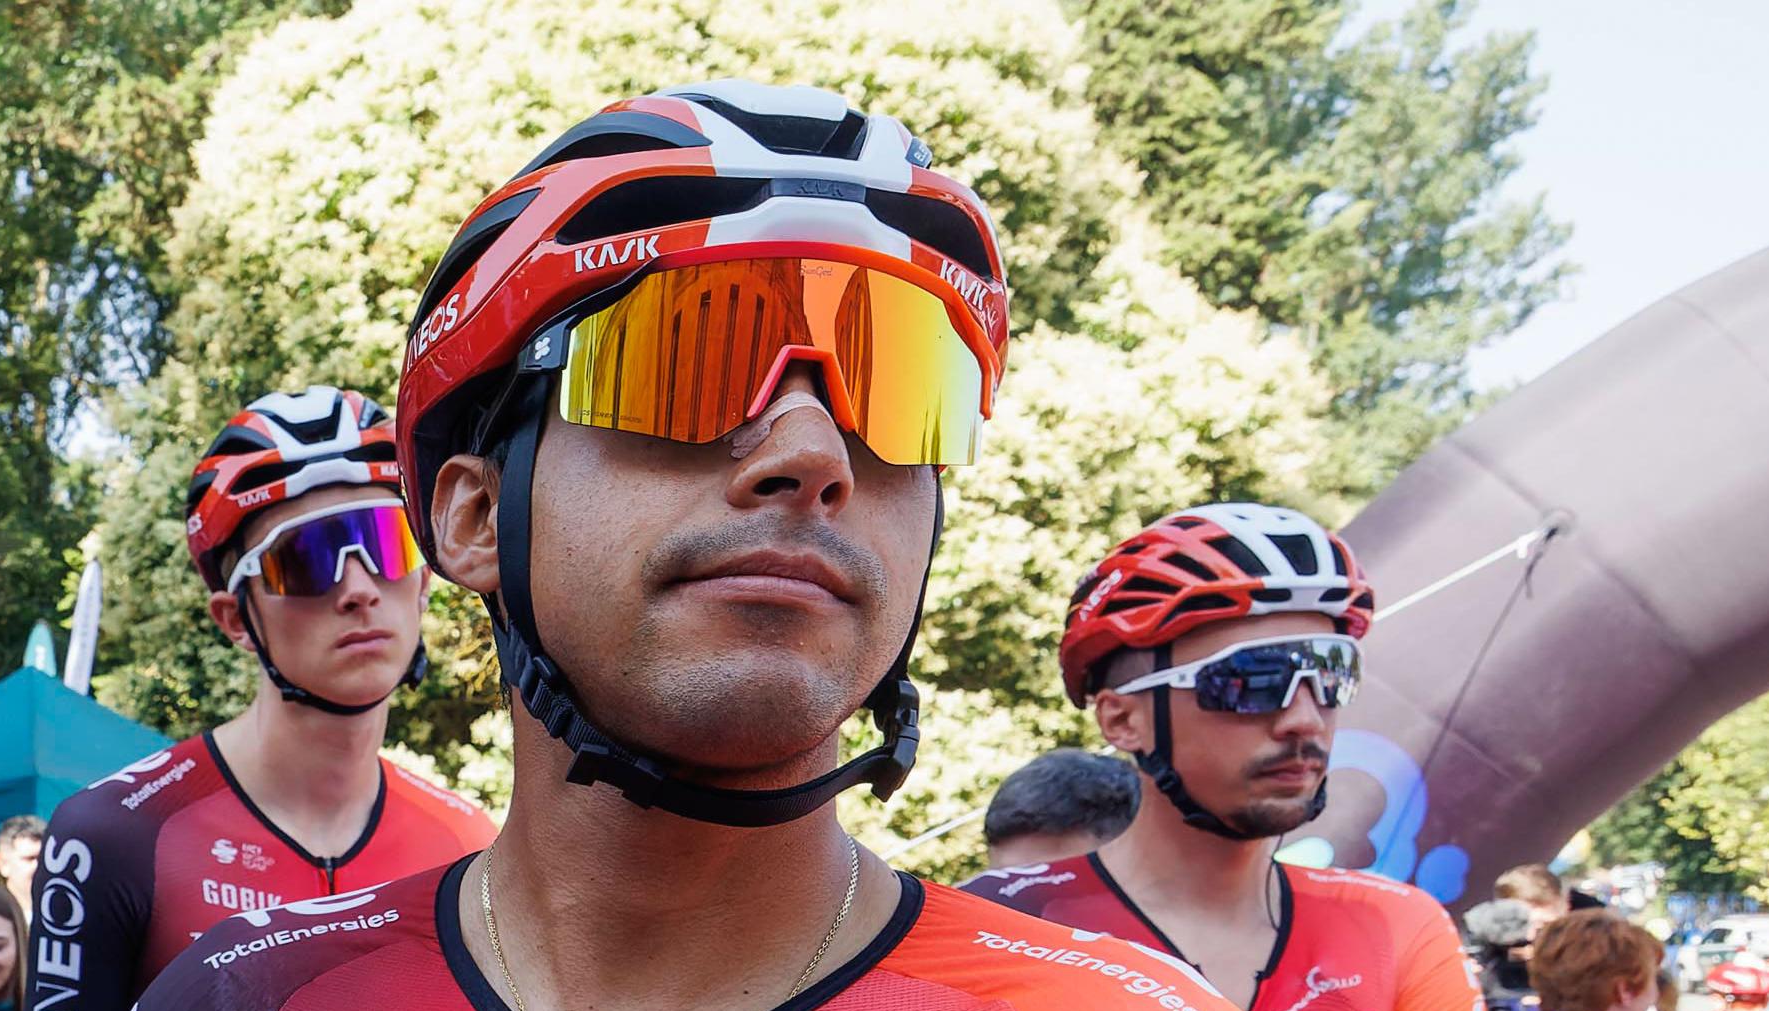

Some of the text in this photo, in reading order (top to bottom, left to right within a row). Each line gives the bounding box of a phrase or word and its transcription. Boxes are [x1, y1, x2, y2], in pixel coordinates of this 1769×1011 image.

[575, 234, 661, 273] KASK
[940, 260, 988, 311] KASK
[406, 292, 460, 372] INEOS
[121, 757, 197, 811] TotalEnergies
[203, 908, 400, 970] TotalEnergies
